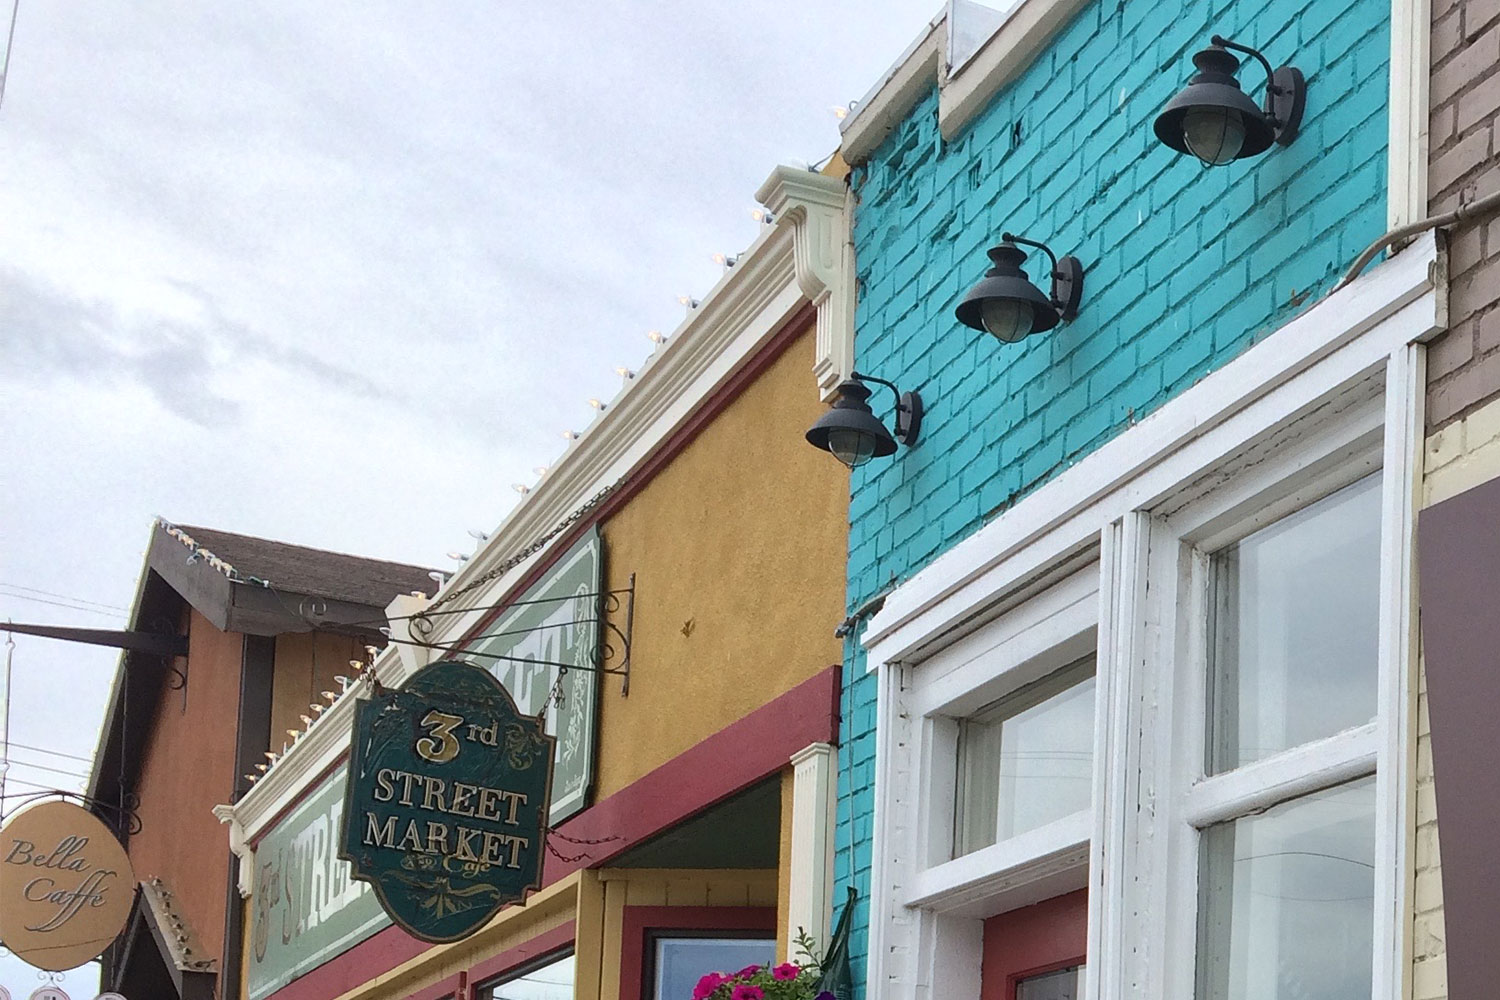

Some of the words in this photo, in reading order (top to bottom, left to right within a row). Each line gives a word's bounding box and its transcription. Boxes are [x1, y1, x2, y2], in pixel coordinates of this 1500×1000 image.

[416, 709, 499, 763] 3rd
[374, 768, 528, 826] STREET
[4, 834, 91, 872] Bella
[363, 812, 529, 869] MARKET
[24, 869, 118, 932] Caffé
